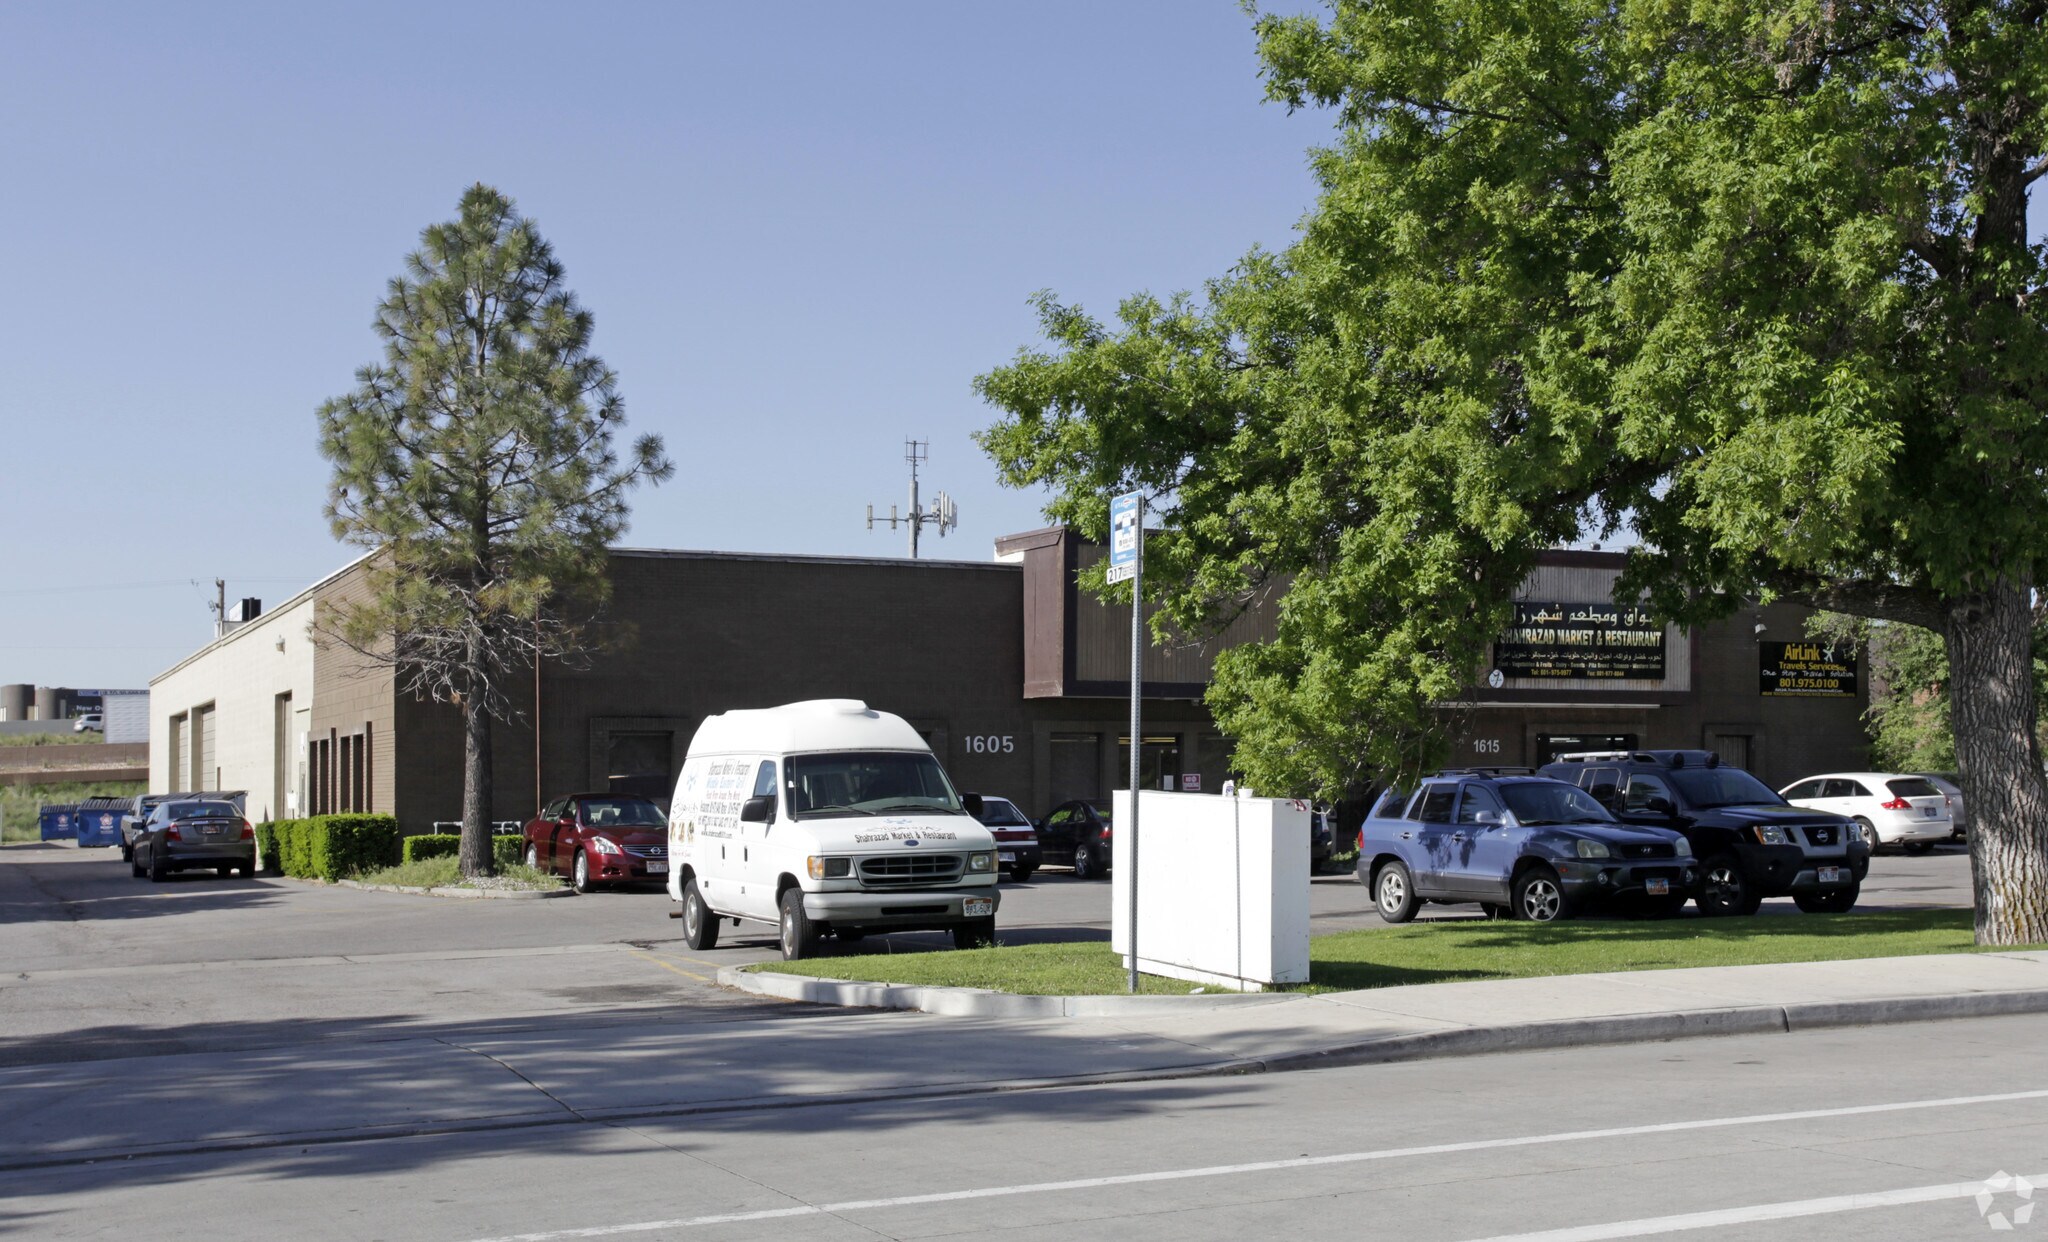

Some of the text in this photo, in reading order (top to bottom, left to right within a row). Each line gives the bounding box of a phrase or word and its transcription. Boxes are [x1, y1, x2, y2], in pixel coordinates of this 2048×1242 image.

[1108, 566, 1123, 582] 217
[1513, 603, 1563, 625] شهرزا
[1567, 605, 1618, 627] ومطعم
[1500, 627, 1662, 647] SHAHRAZAD MARKET & RESTAURANT
[1784, 643, 1820, 660] AirLink
[1779, 661, 1806, 670] Travels
[1808, 661, 1839, 671] Services
[1780, 678, 1839, 688] 801.975.0100
[965, 735, 1014, 753] 1605
[1473, 739, 1500, 753] 1615
[855, 834, 889, 843] Shahrazad
[891, 831, 914, 840] Market
[922, 831, 957, 840] Restaurant
